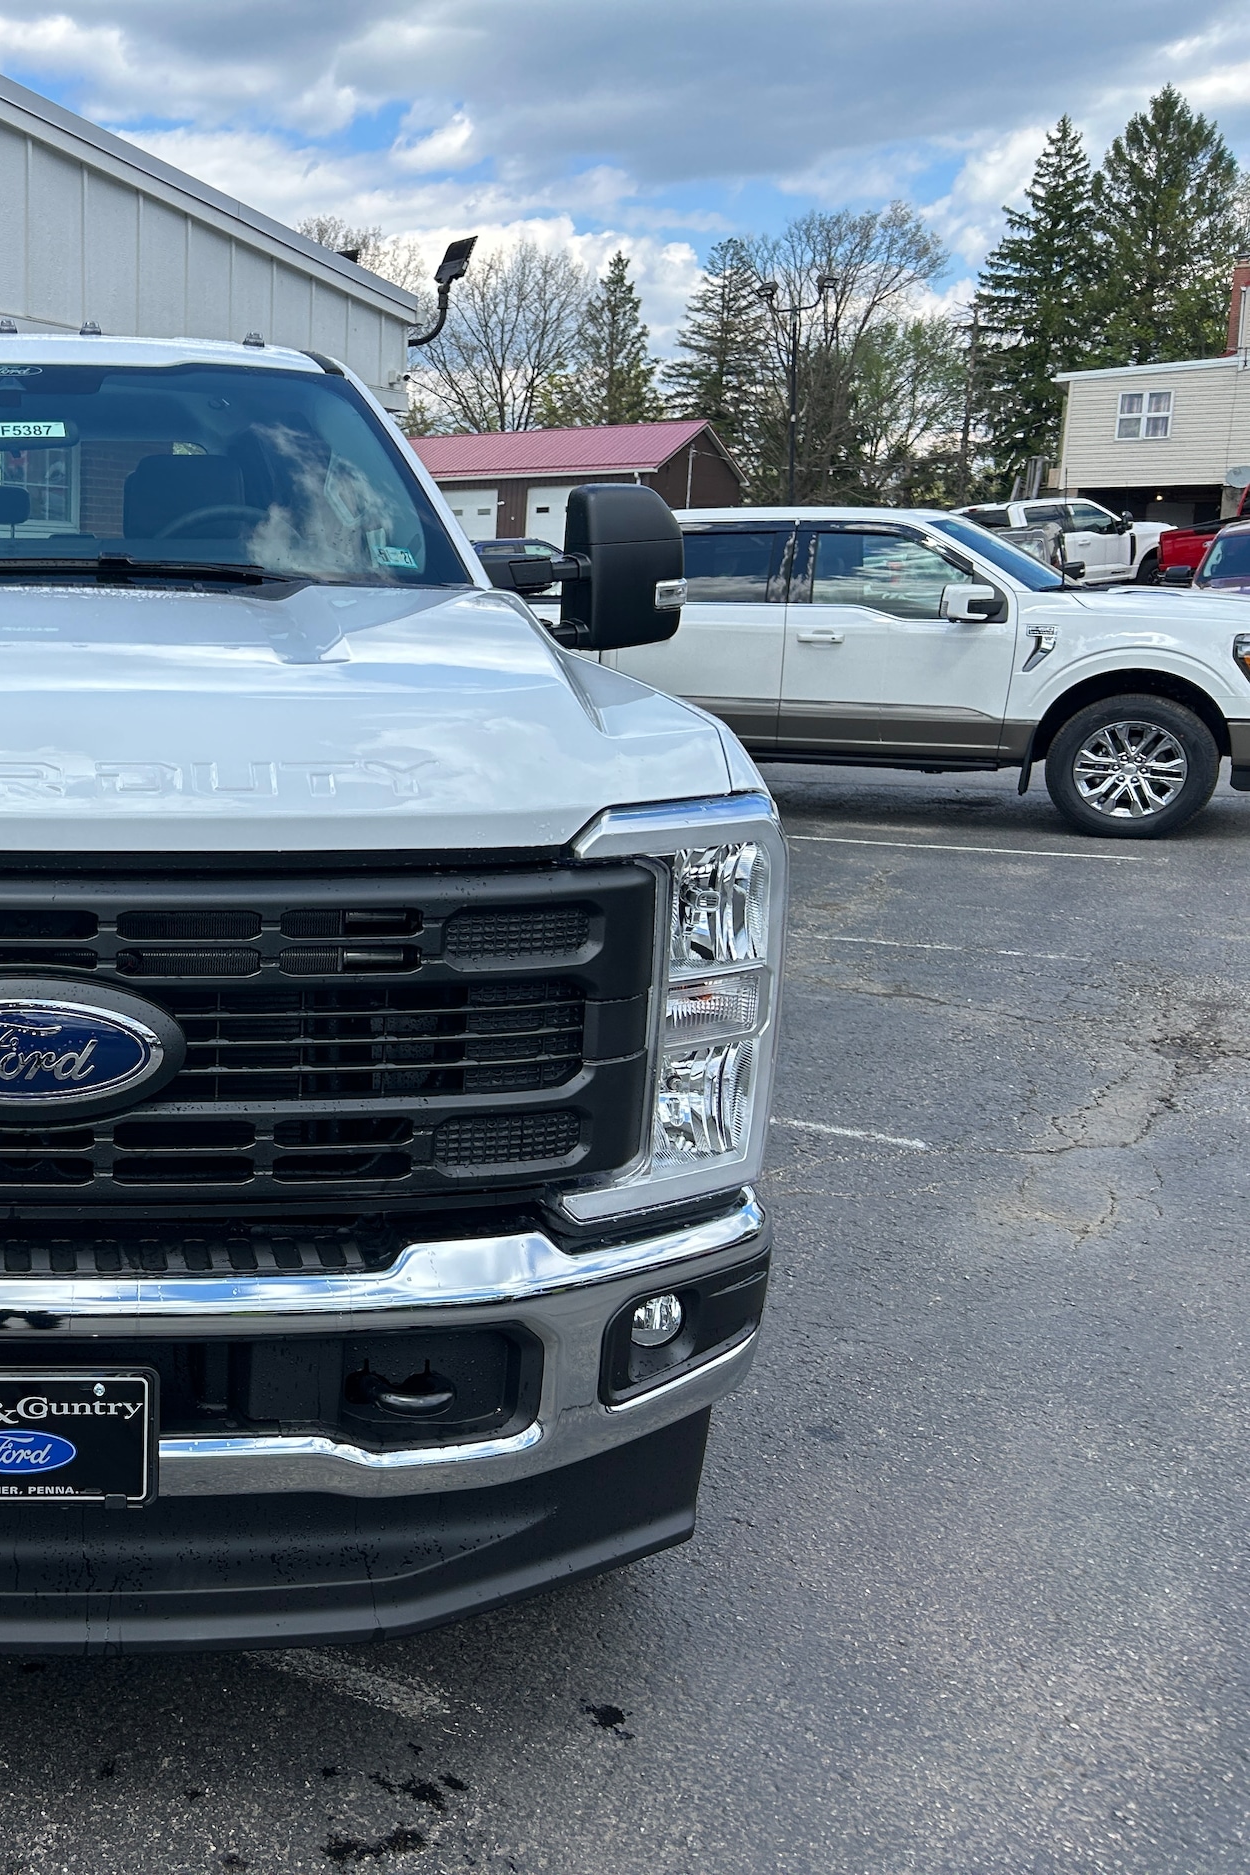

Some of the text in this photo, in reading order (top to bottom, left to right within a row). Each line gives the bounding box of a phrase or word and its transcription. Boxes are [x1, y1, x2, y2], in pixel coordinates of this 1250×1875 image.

[1, 425, 53, 436] F5387
[94, 759, 440, 797] DUTY
[17, 1396, 144, 1419] Country
[28, 1486, 80, 1495] PENNA.
